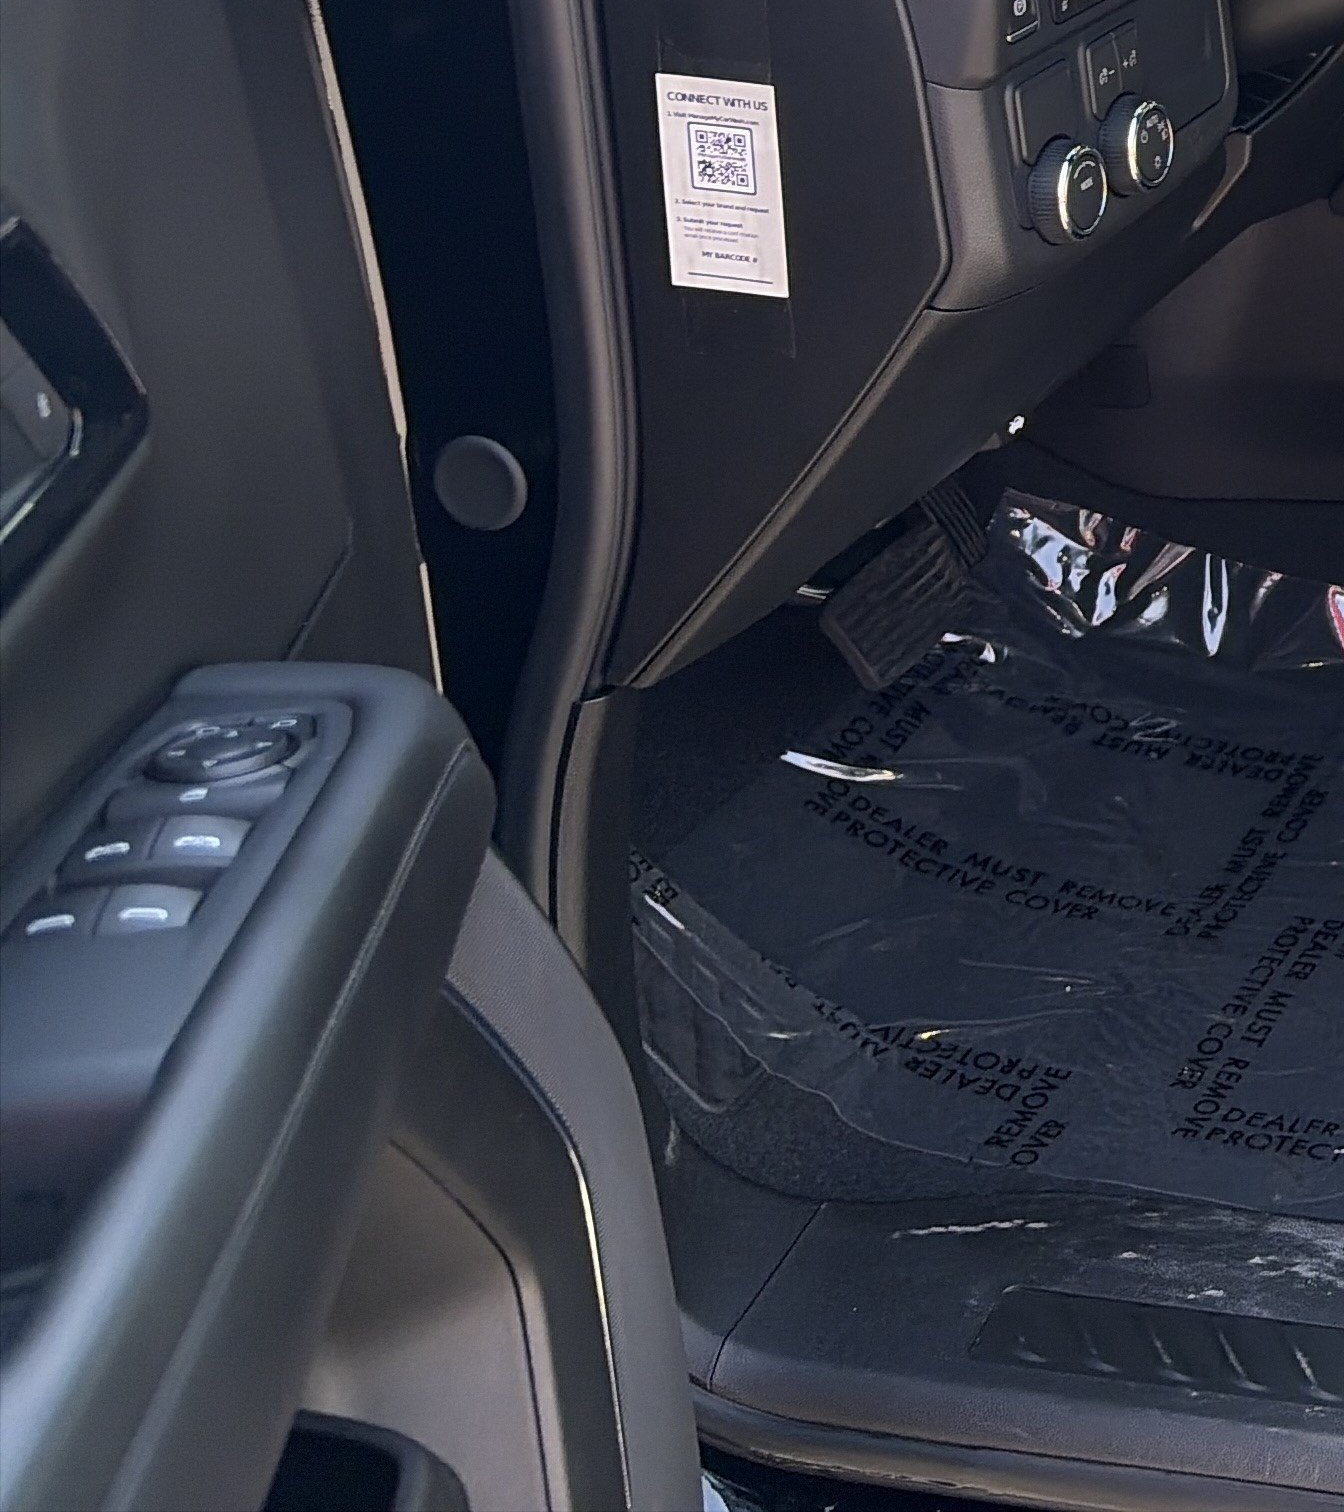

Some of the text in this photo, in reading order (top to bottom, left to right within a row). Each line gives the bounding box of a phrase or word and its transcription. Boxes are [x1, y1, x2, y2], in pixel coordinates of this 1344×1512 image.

[667, 91, 768, 111] CONNECT WITH US
[831, 811, 1099, 922] PROTECTIVE COVER
[848, 794, 1177, 918] DEALER MUST REMOVE
[1169, 915, 1316, 1089] PROTECTIVE COVER
[1240, 989, 1296, 1048] MUST
[904, 1055, 1021, 1102] DEALER
[984, 1064, 1074, 1149] REMOVE
[1171, 1056, 1251, 1139] REMOVE
[1222, 1106, 1341, 1137] DEALER
